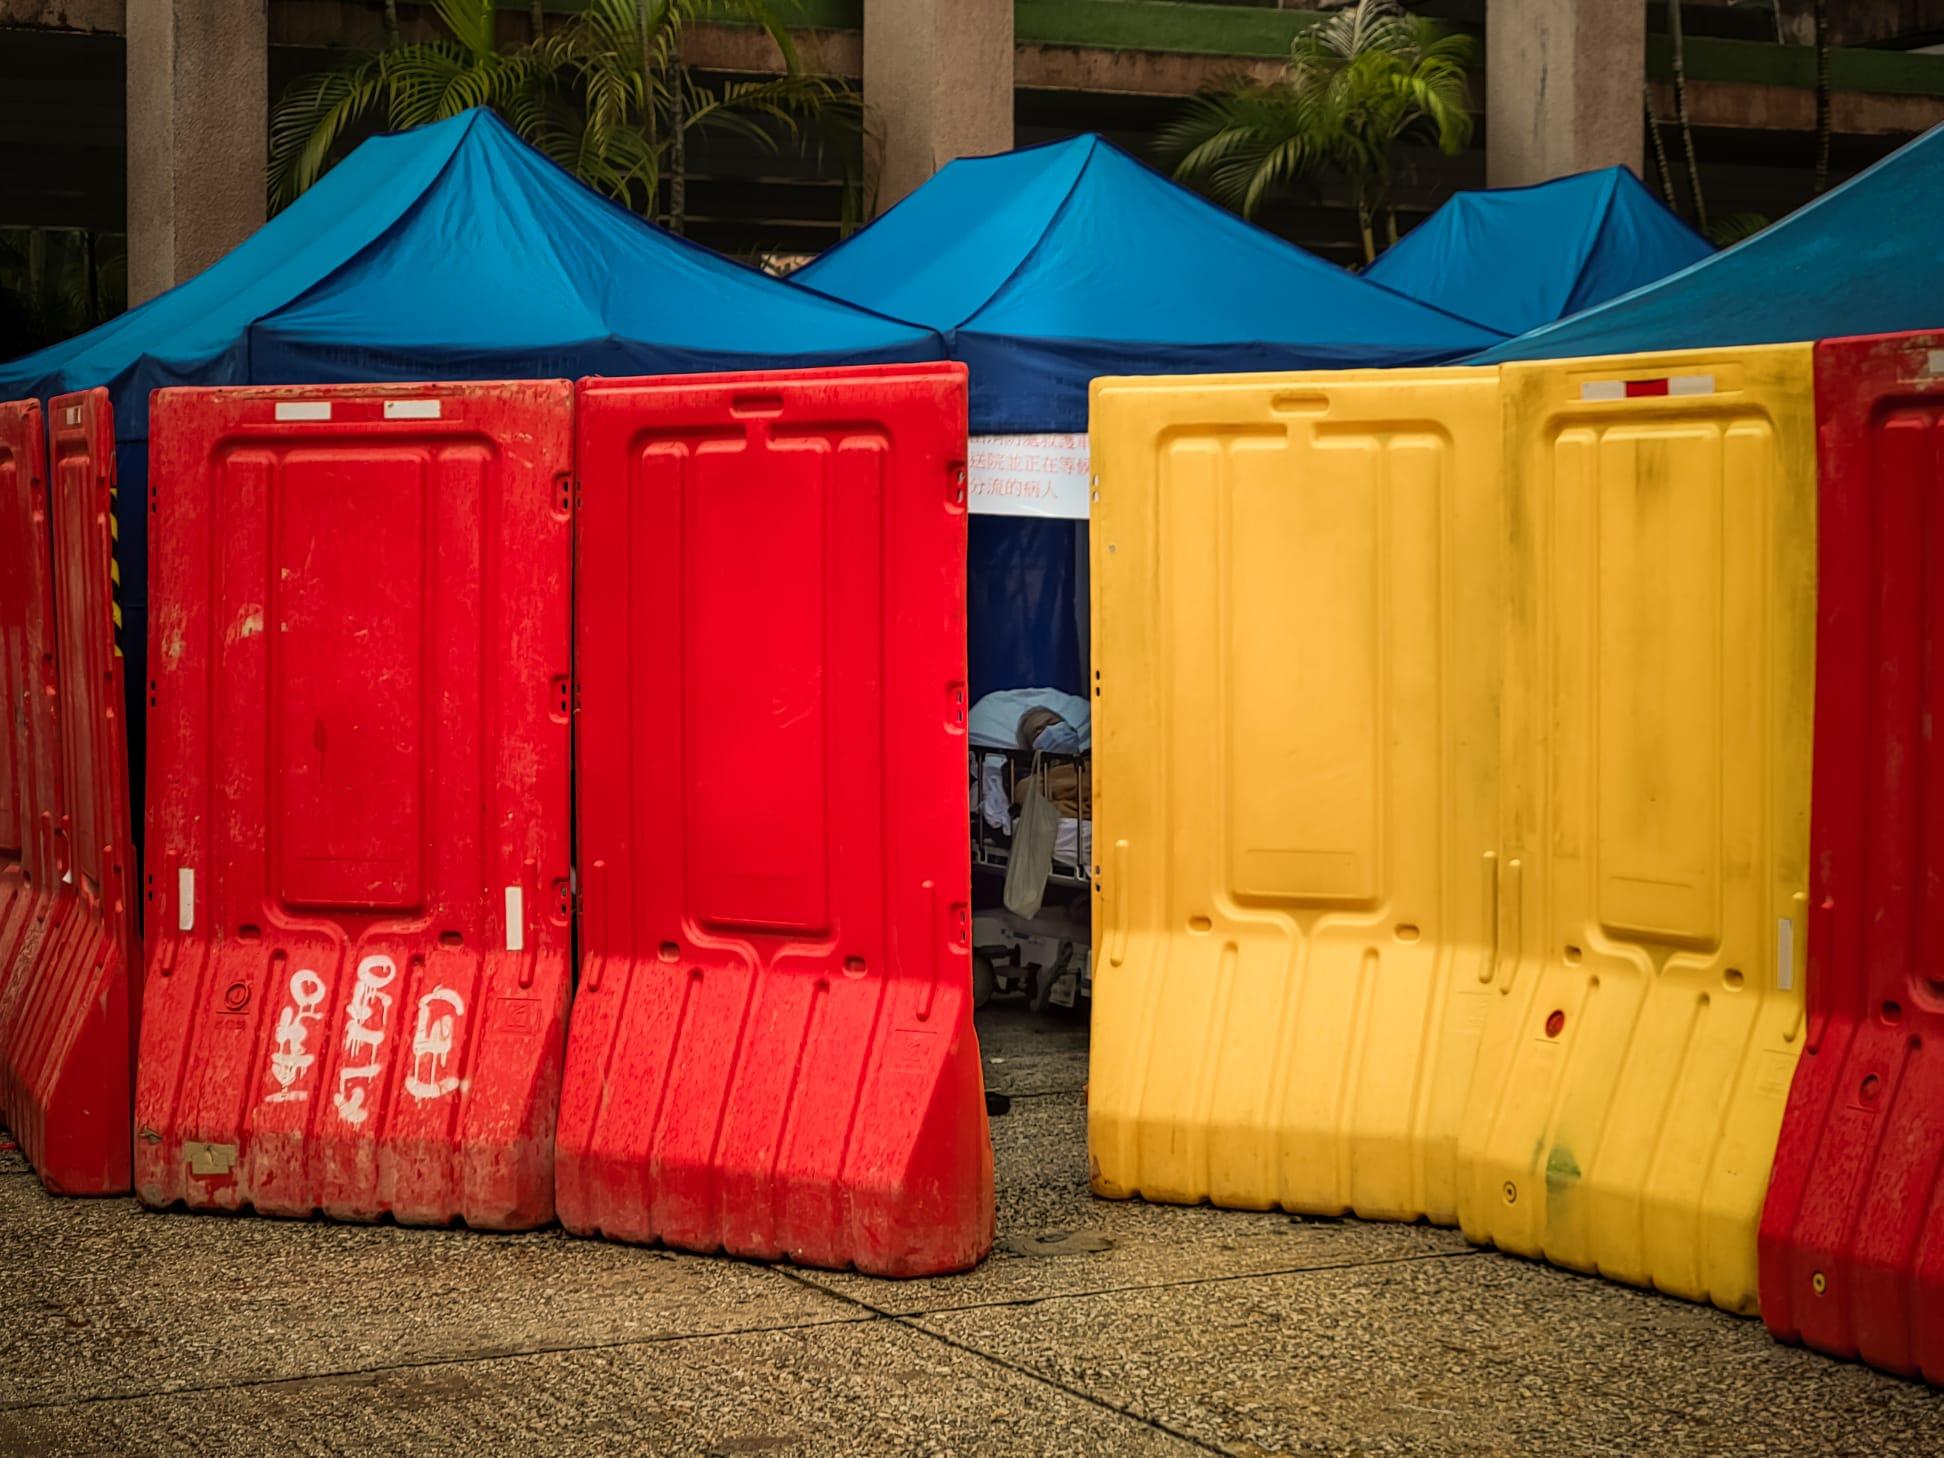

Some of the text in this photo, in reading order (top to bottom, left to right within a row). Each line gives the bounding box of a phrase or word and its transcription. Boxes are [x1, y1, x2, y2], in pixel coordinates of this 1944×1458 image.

[969, 478, 1058, 498] 分流的病人
